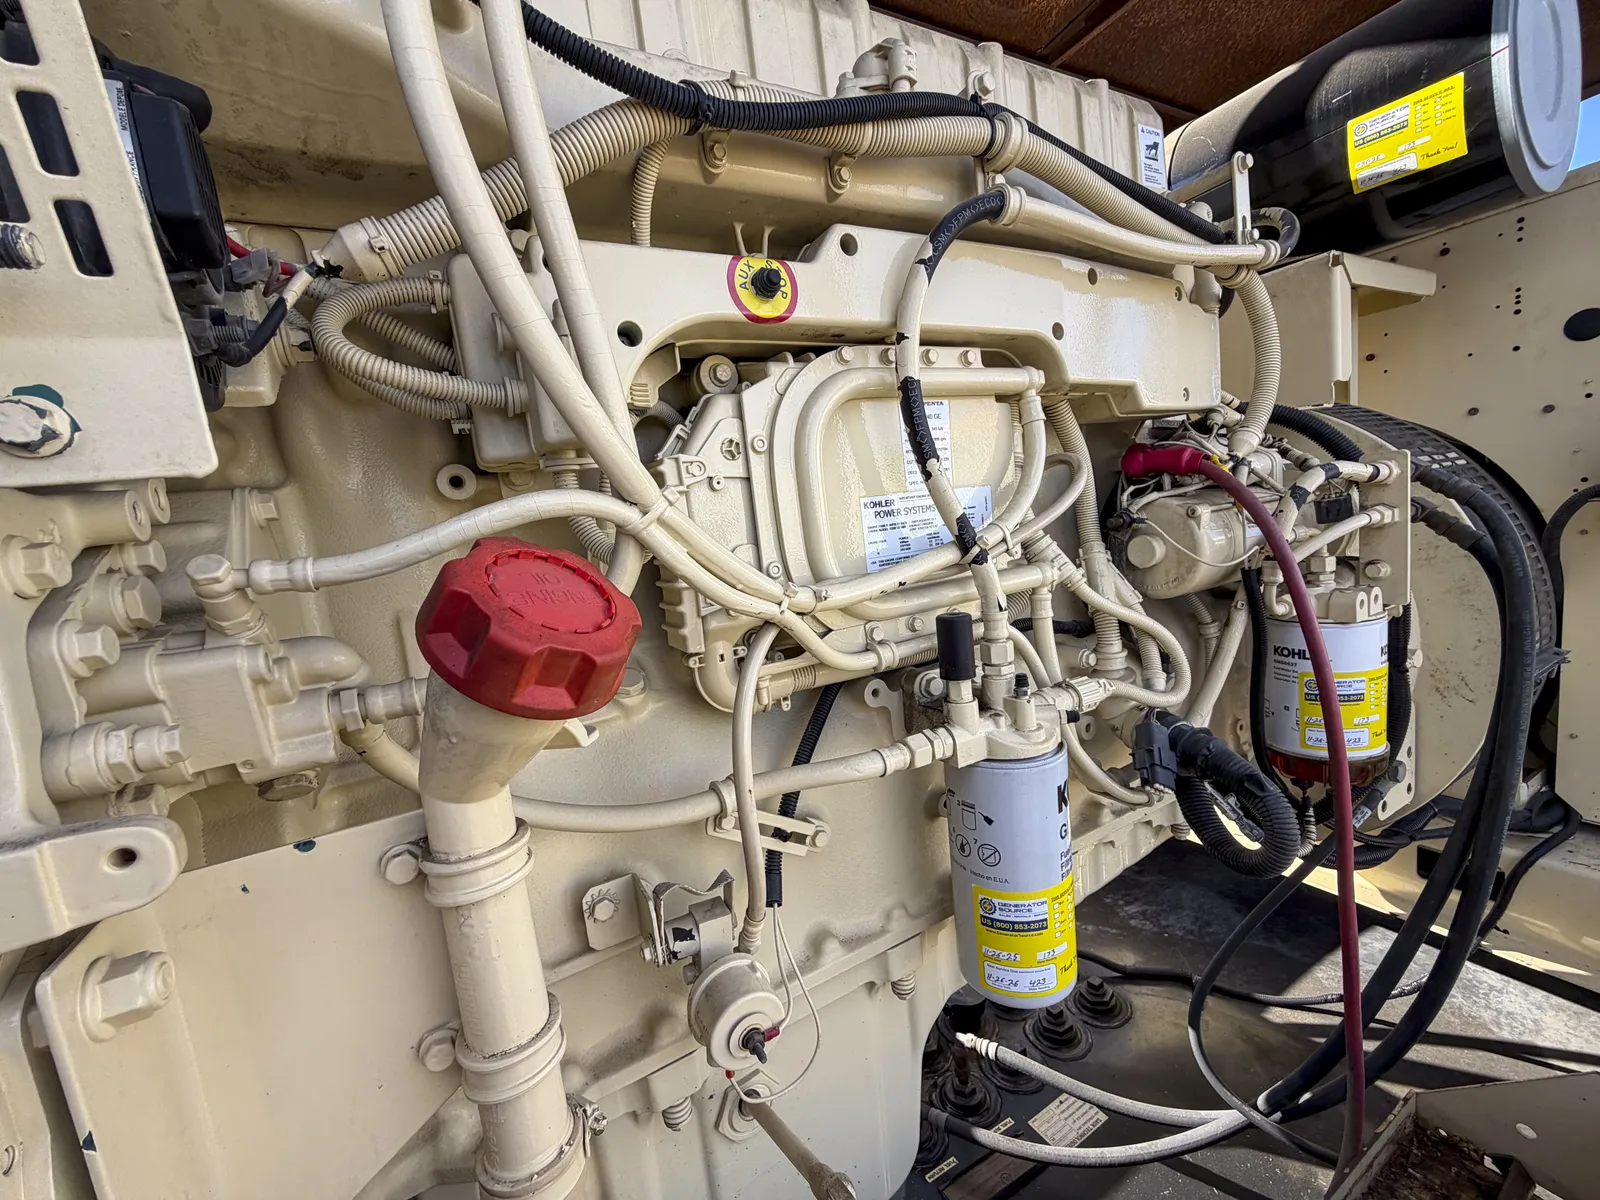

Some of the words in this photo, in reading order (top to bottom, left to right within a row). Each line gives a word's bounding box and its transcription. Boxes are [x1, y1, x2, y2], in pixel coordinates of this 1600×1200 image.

[1420, 149, 1441, 161] Thank
[738, 259, 754, 290] AUX
[863, 499, 896, 510] KOHLER
[874, 508, 902, 519] POWER
[903, 504, 936, 516] SYSTEMS
[1273, 645, 1310, 660] KOHL
[970, 869, 985, 880] Hecho
[993, 876, 1010, 884] E.U.A.
[981, 917, 992, 925] US
[993, 921, 1013, 931] (800)
[1014, 921, 1047, 930] 853-2073
[1043, 949, 1056, 959] 173
[1029, 977, 1046, 987] 423
